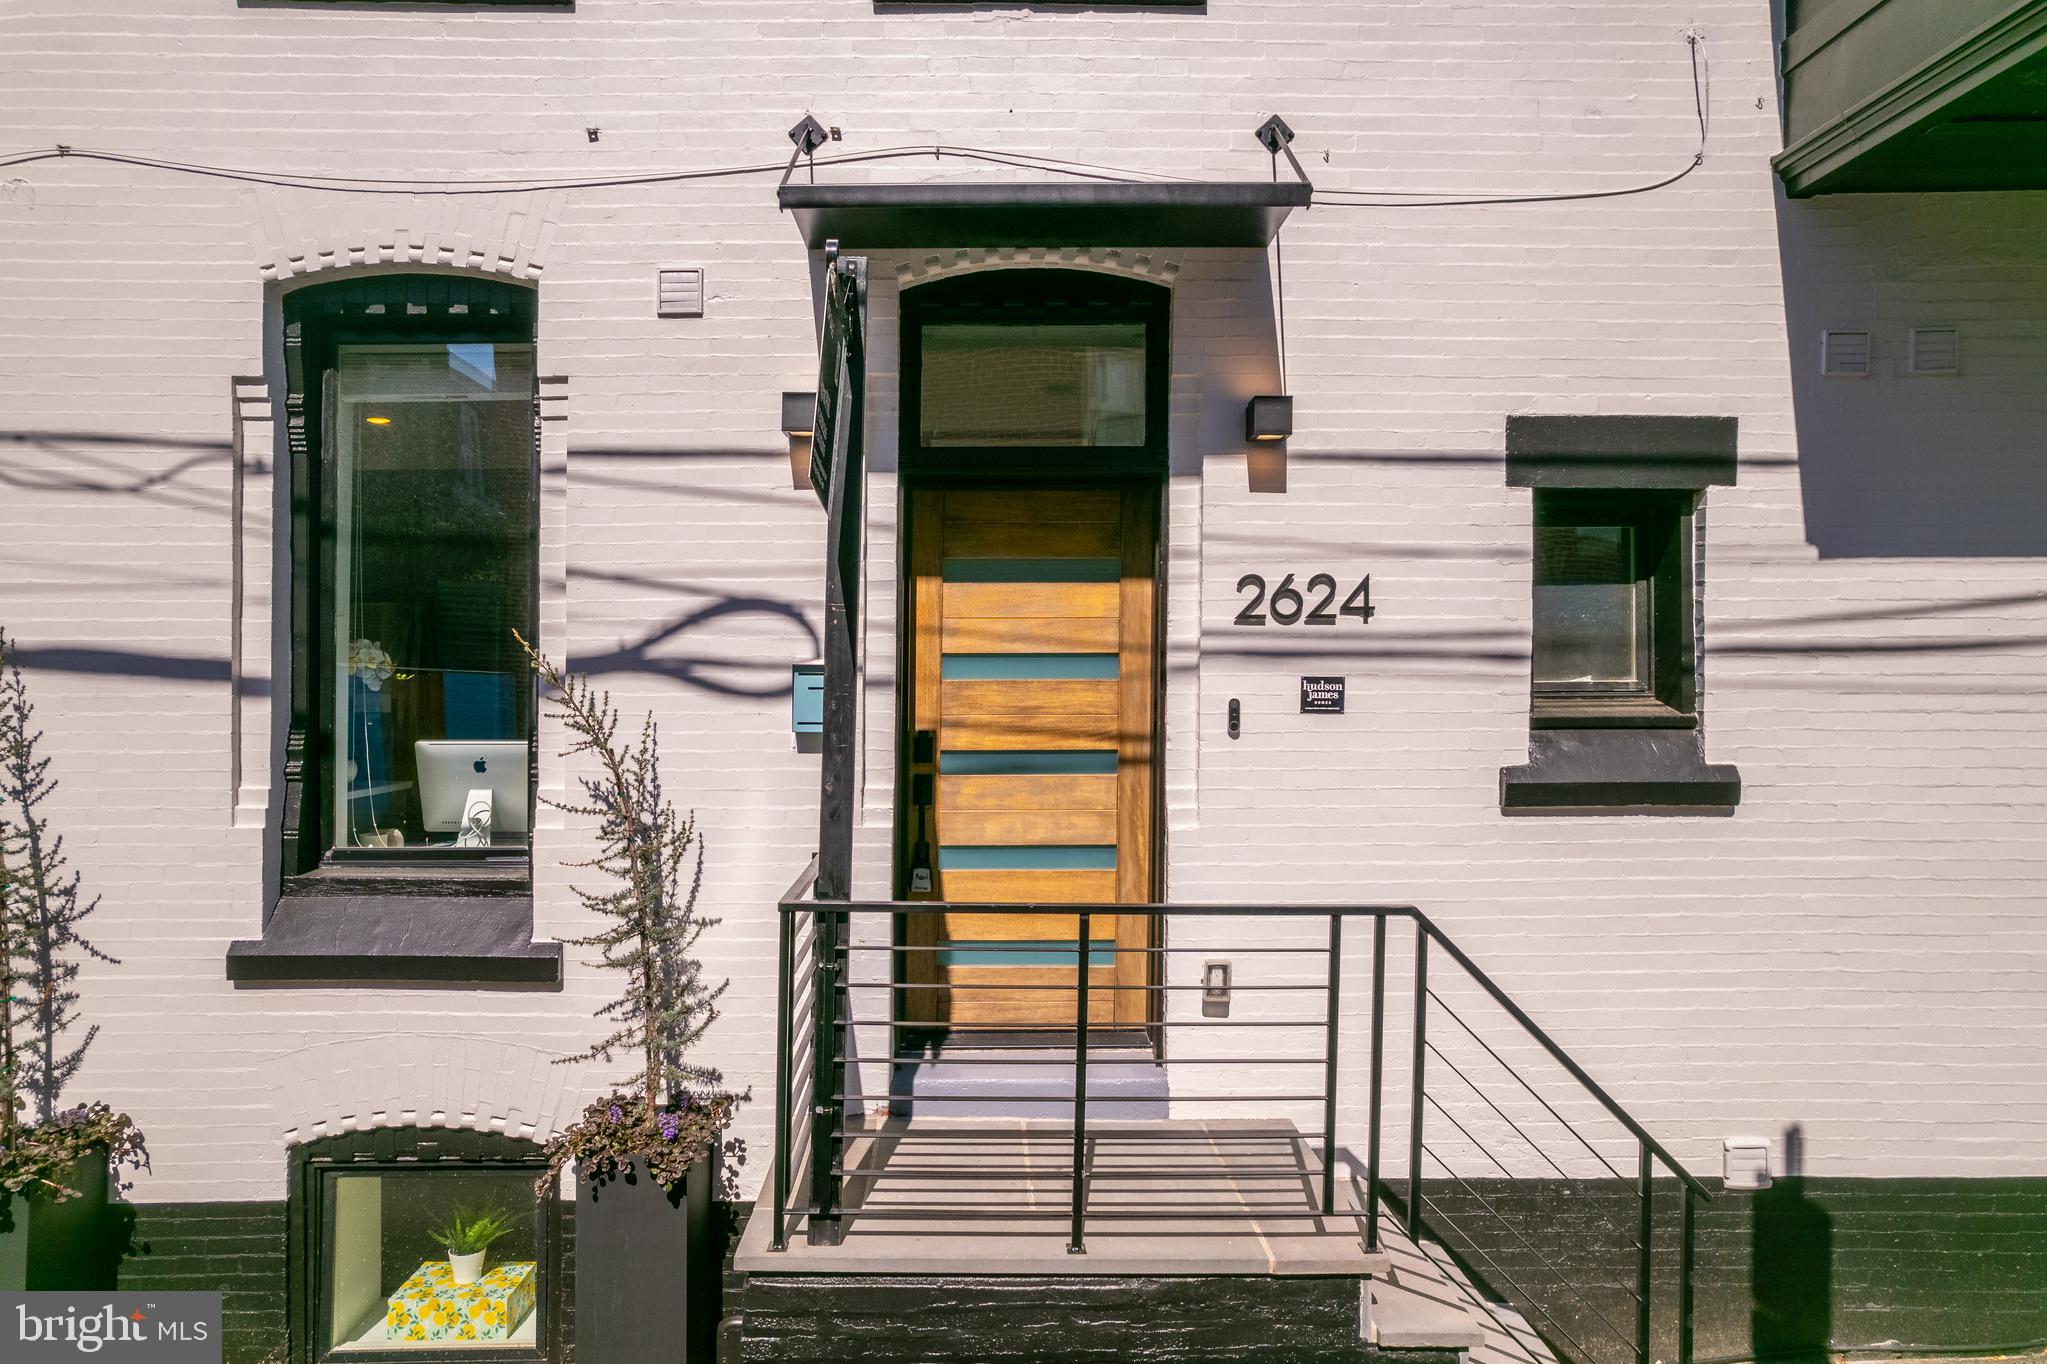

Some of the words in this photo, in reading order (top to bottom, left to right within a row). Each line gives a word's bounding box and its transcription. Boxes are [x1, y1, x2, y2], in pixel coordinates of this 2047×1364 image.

[1234, 573, 1375, 625] 2624
[1302, 680, 1343, 692] hudson
[1307, 691, 1339, 701] james
